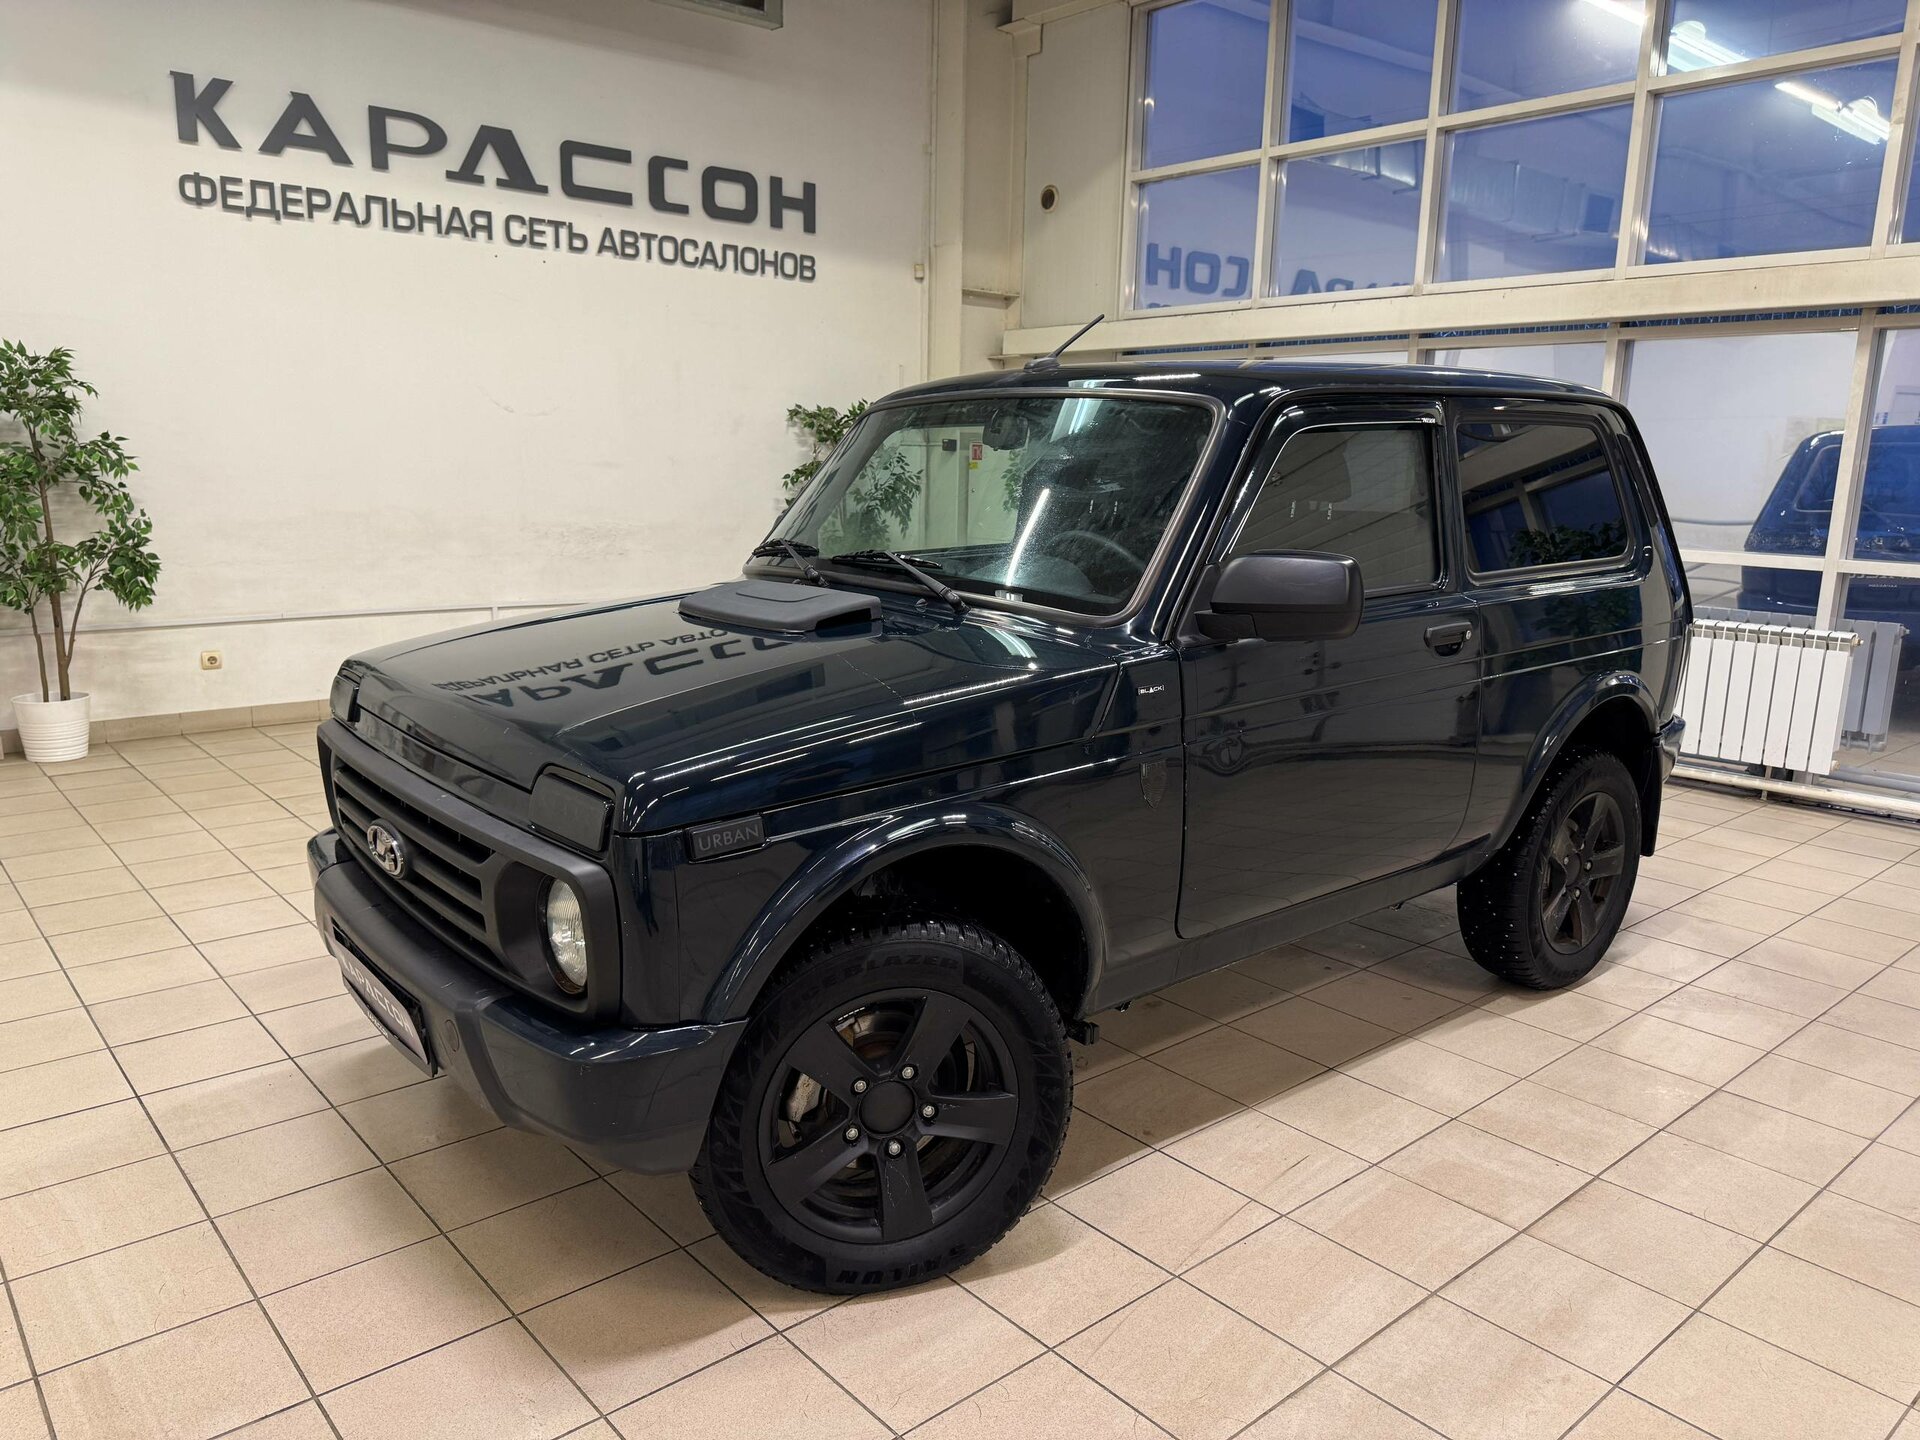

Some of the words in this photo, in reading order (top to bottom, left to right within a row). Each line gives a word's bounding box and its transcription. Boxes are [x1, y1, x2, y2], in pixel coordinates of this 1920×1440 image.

[169, 70, 816, 234] КАРАССОН
[177, 171, 494, 241] ФЕДЕРАЛЬНАЯ
[504, 214, 588, 253] СЕТЬ
[598, 226, 817, 282] АВТОСАЛОНОВ
[698, 824, 760, 851] URBAN
